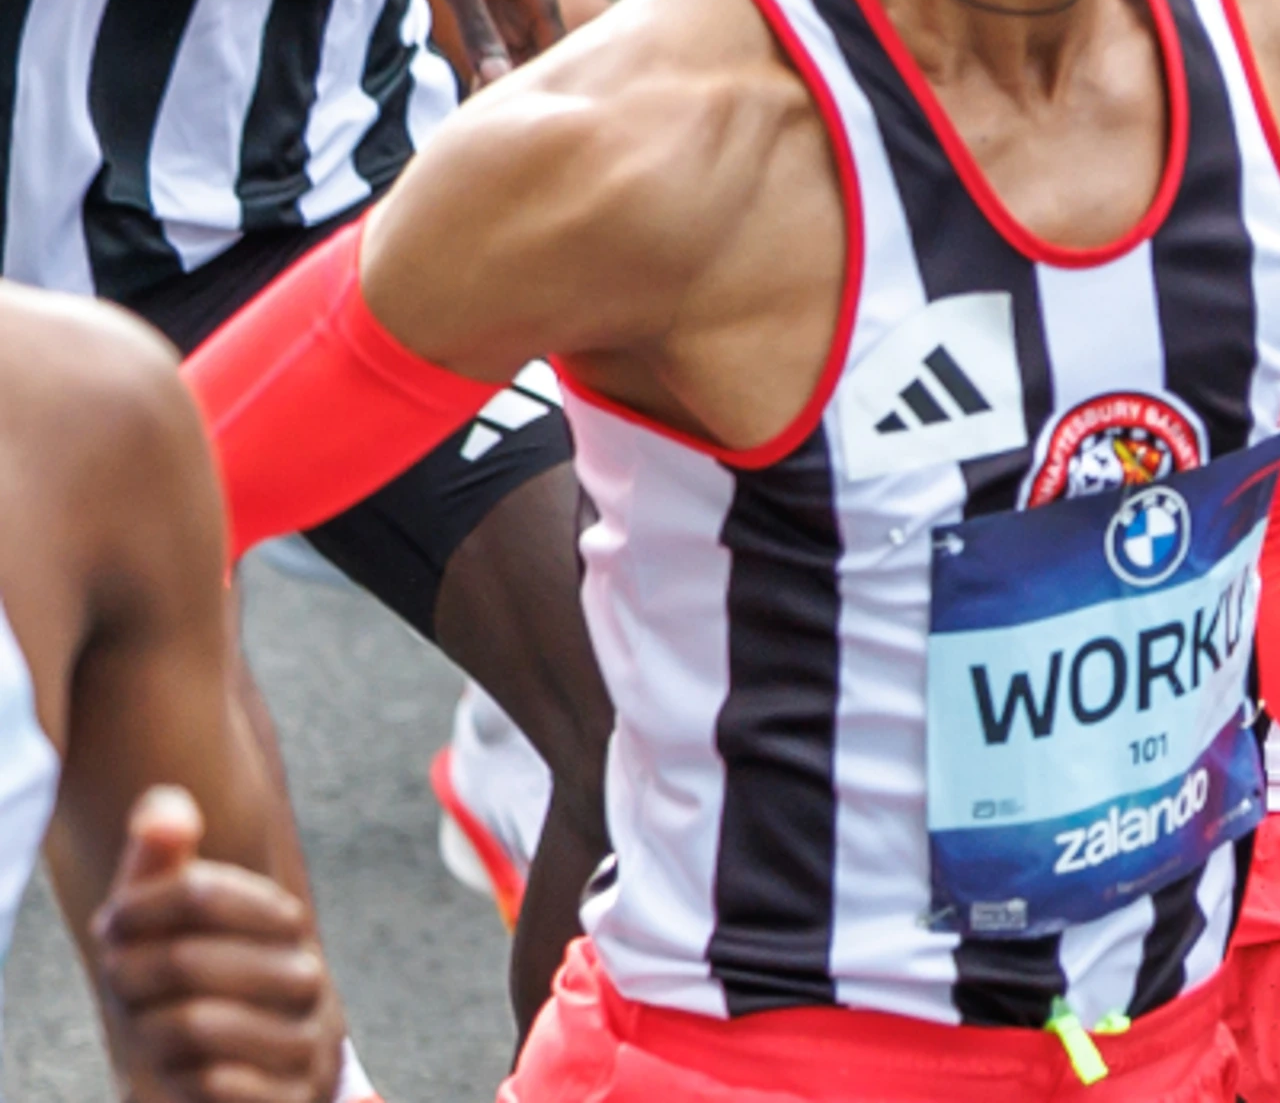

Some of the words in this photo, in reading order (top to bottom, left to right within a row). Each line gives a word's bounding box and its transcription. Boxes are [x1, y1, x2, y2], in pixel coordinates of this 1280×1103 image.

[968, 562, 1250, 746] WORKU
[1129, 733, 1169, 765] 101
[1053, 768, 1209, 874] zalando
